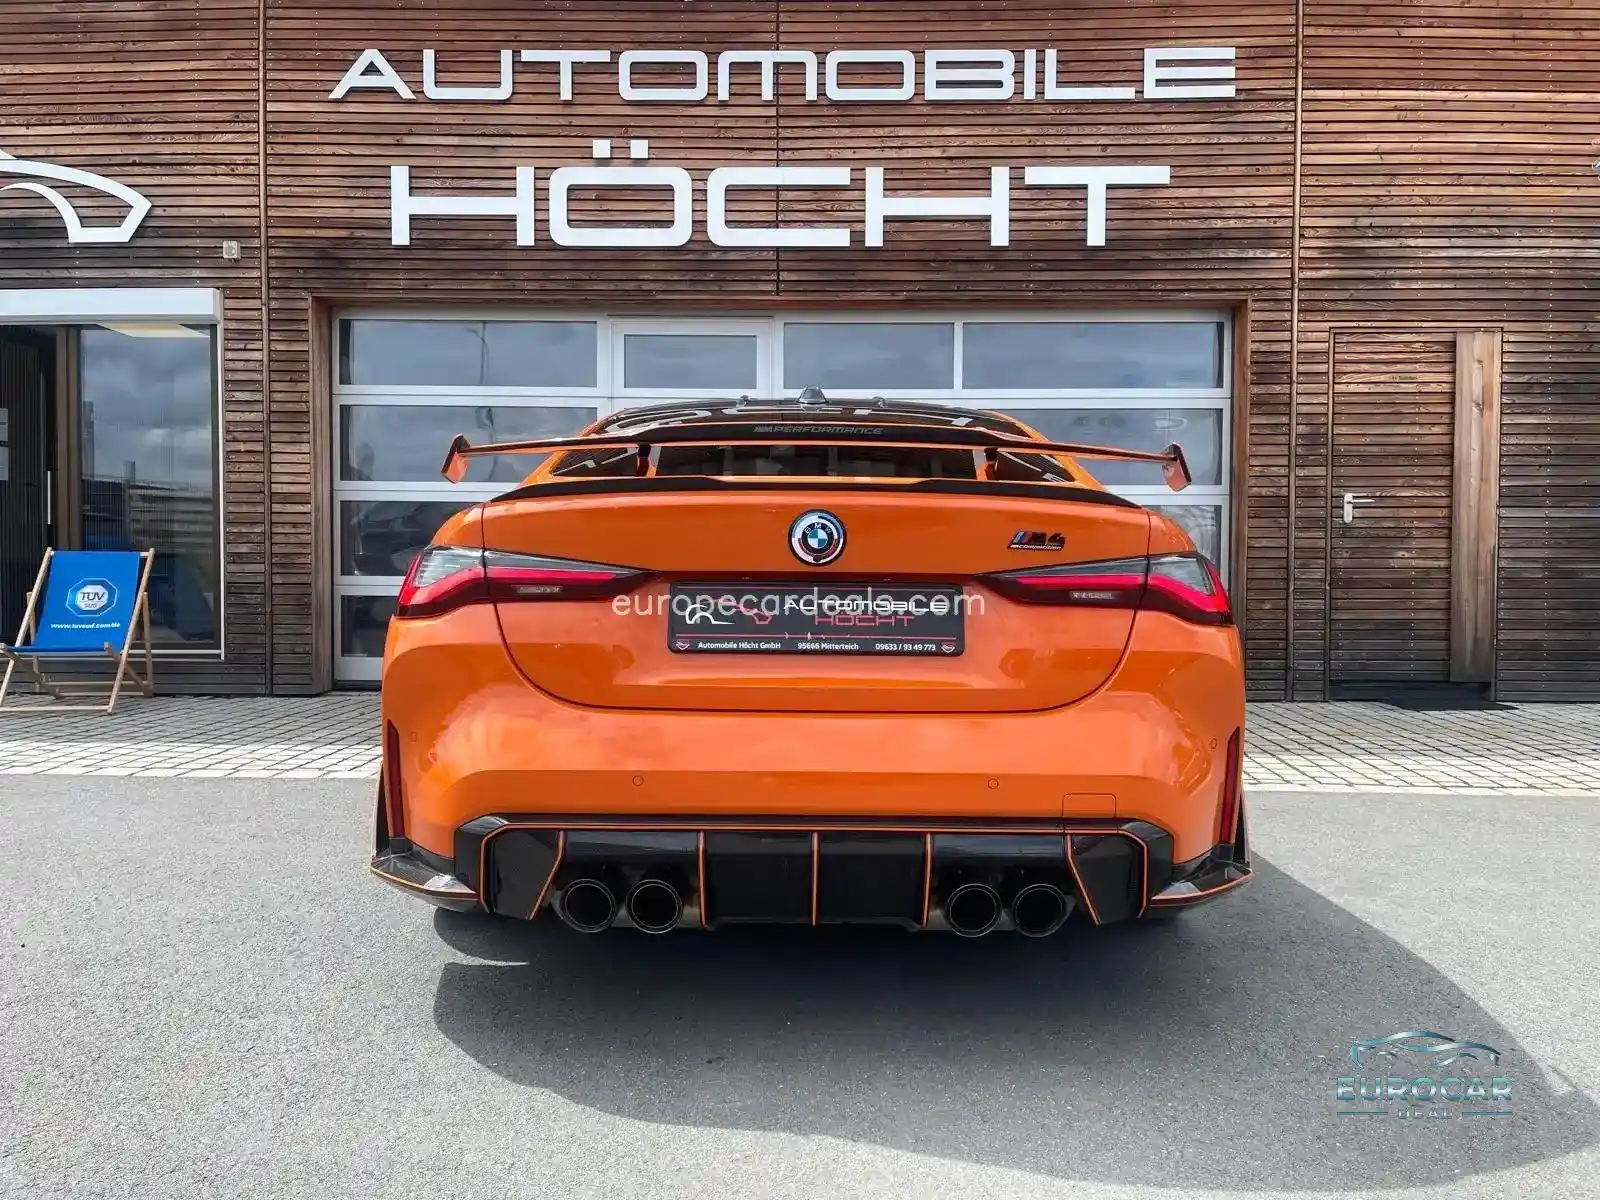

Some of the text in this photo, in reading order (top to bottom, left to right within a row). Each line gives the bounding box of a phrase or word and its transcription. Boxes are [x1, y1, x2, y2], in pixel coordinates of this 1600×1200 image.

[328, 47, 1237, 101] AUTOMOBILE
[390, 139, 1171, 248] HÖCHT
[804, 521, 832, 534] BMW
[80, 591, 106, 601] TÜV
[783, 599, 948, 612] AUTOMOBILE
[814, 612, 916, 627] HÖCHT
[698, 641, 781, 649] Automobile Höcht GmbH
[798, 642, 859, 650] 95666 Mitterteich
[875, 643, 897, 651] 09633
[903, 643, 912, 651] 93
[913, 643, 923, 651] 49
[923, 643, 936, 651] 773
